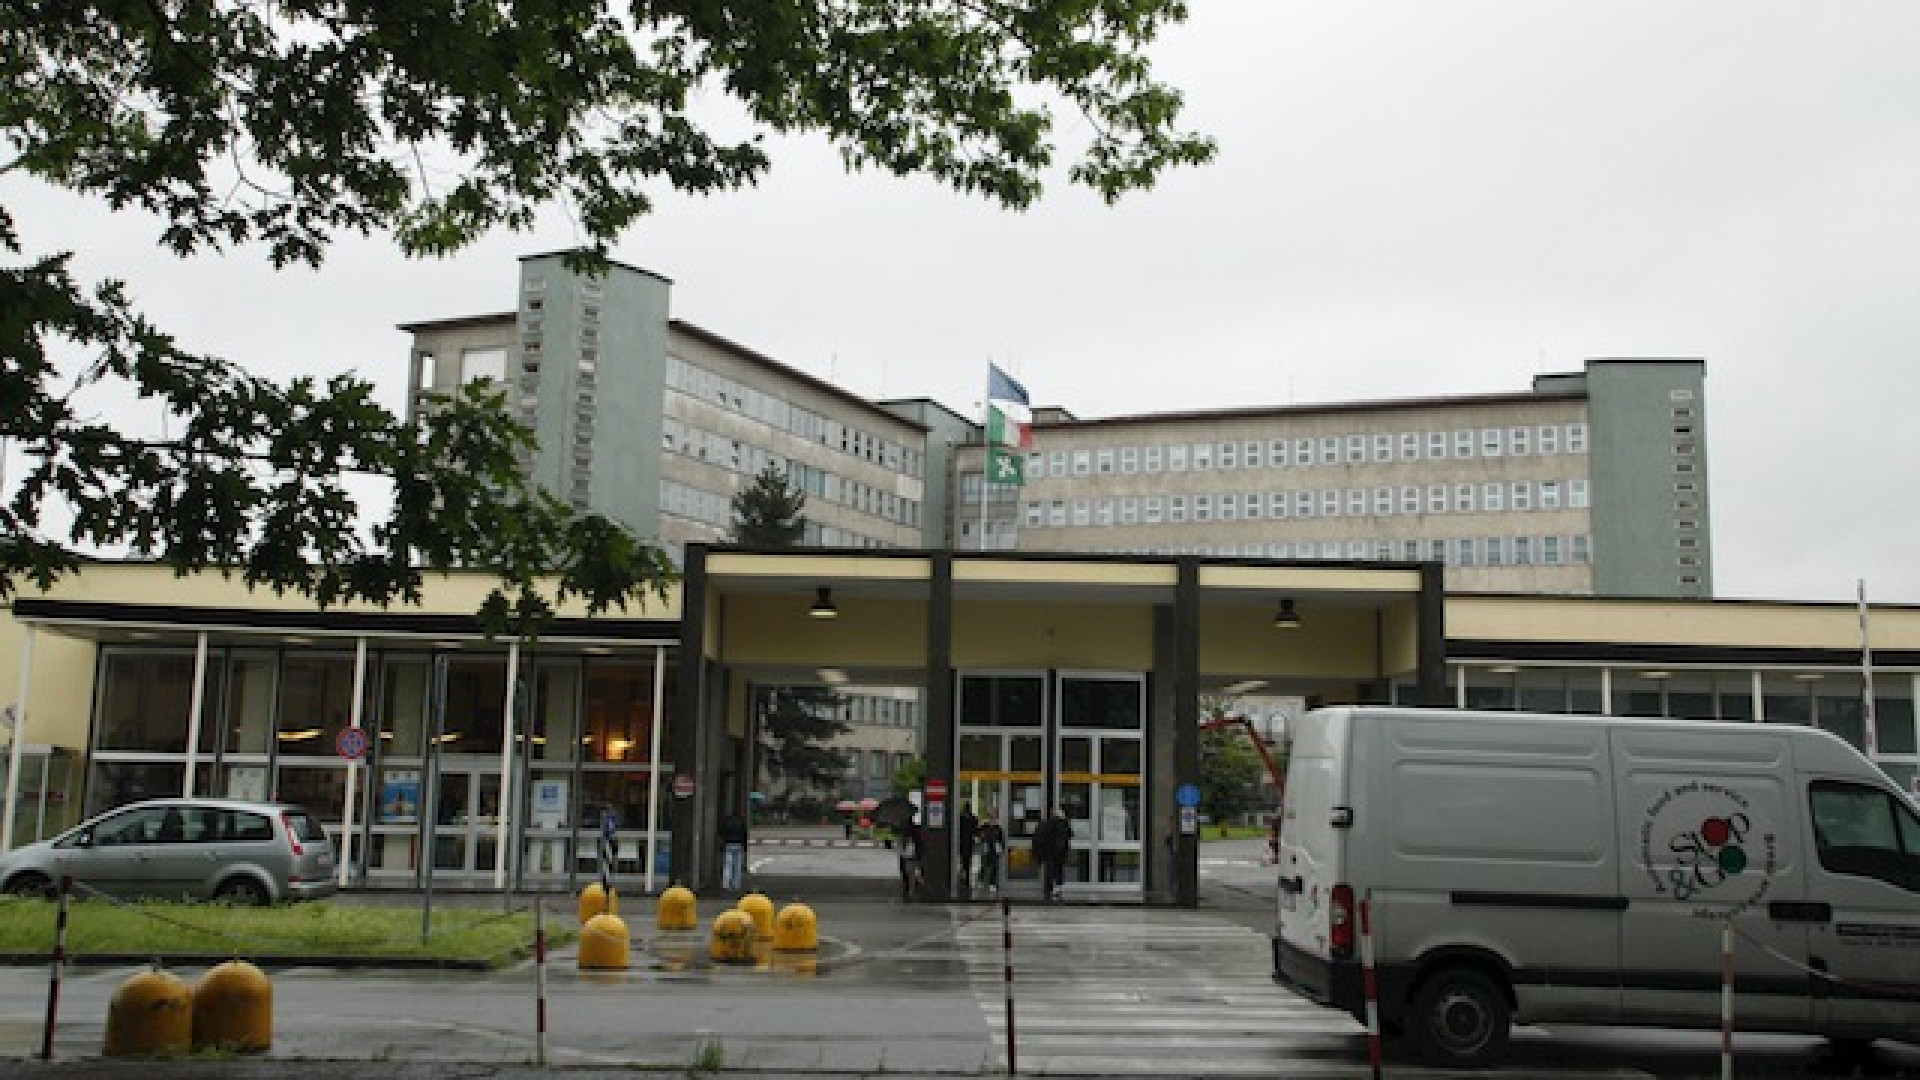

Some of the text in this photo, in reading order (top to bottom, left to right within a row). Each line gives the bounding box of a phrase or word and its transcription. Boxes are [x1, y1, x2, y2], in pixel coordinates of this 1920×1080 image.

[1646, 790, 1673, 817] food
[1674, 781, 1698, 796] and
[1702, 783, 1749, 808] service
